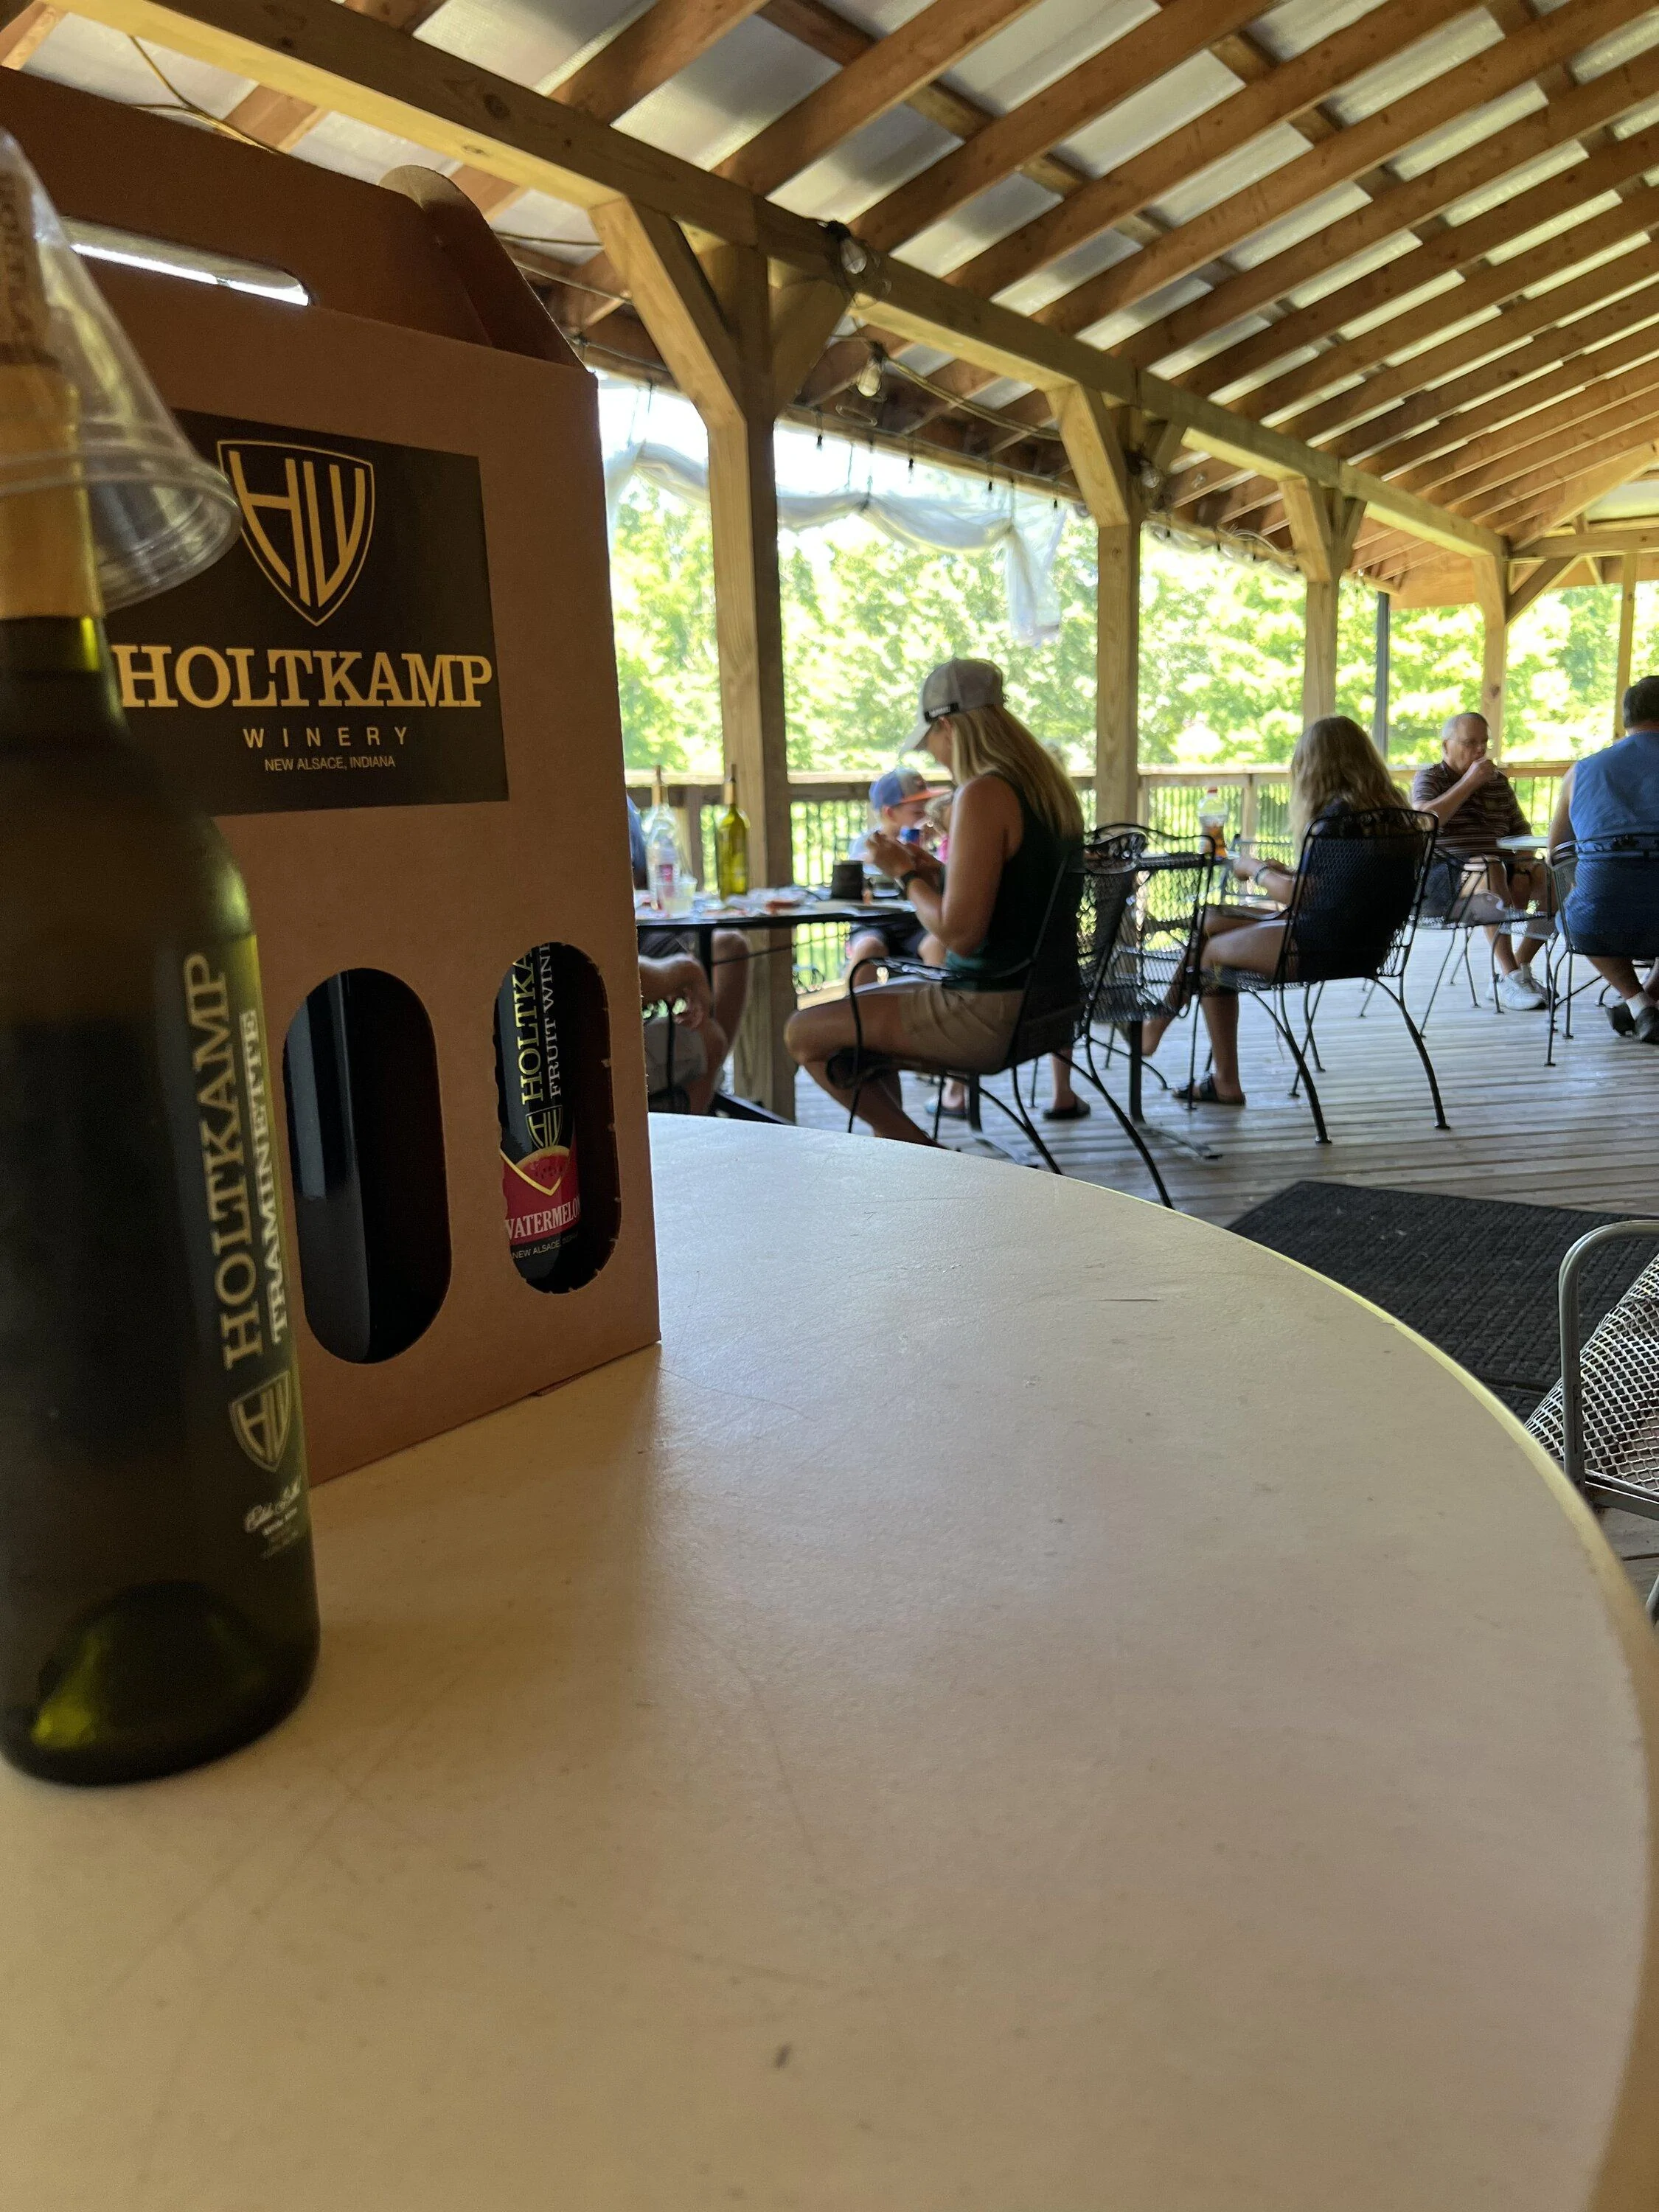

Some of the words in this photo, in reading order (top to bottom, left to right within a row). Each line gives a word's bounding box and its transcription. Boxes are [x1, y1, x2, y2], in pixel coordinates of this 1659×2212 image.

[111, 644, 493, 709] HOLTKAMP
[242, 726, 407, 749] WINERY
[264, 757, 293, 772] NEW
[349, 754, 396, 769] INDIANA
[544, 1018, 562, 1099] FRUIT
[184, 953, 263, 1370] HOLTKAMP
[239, 1009, 288, 1344] TRAMINETTE
[512, 1248, 532, 1259] NEW
